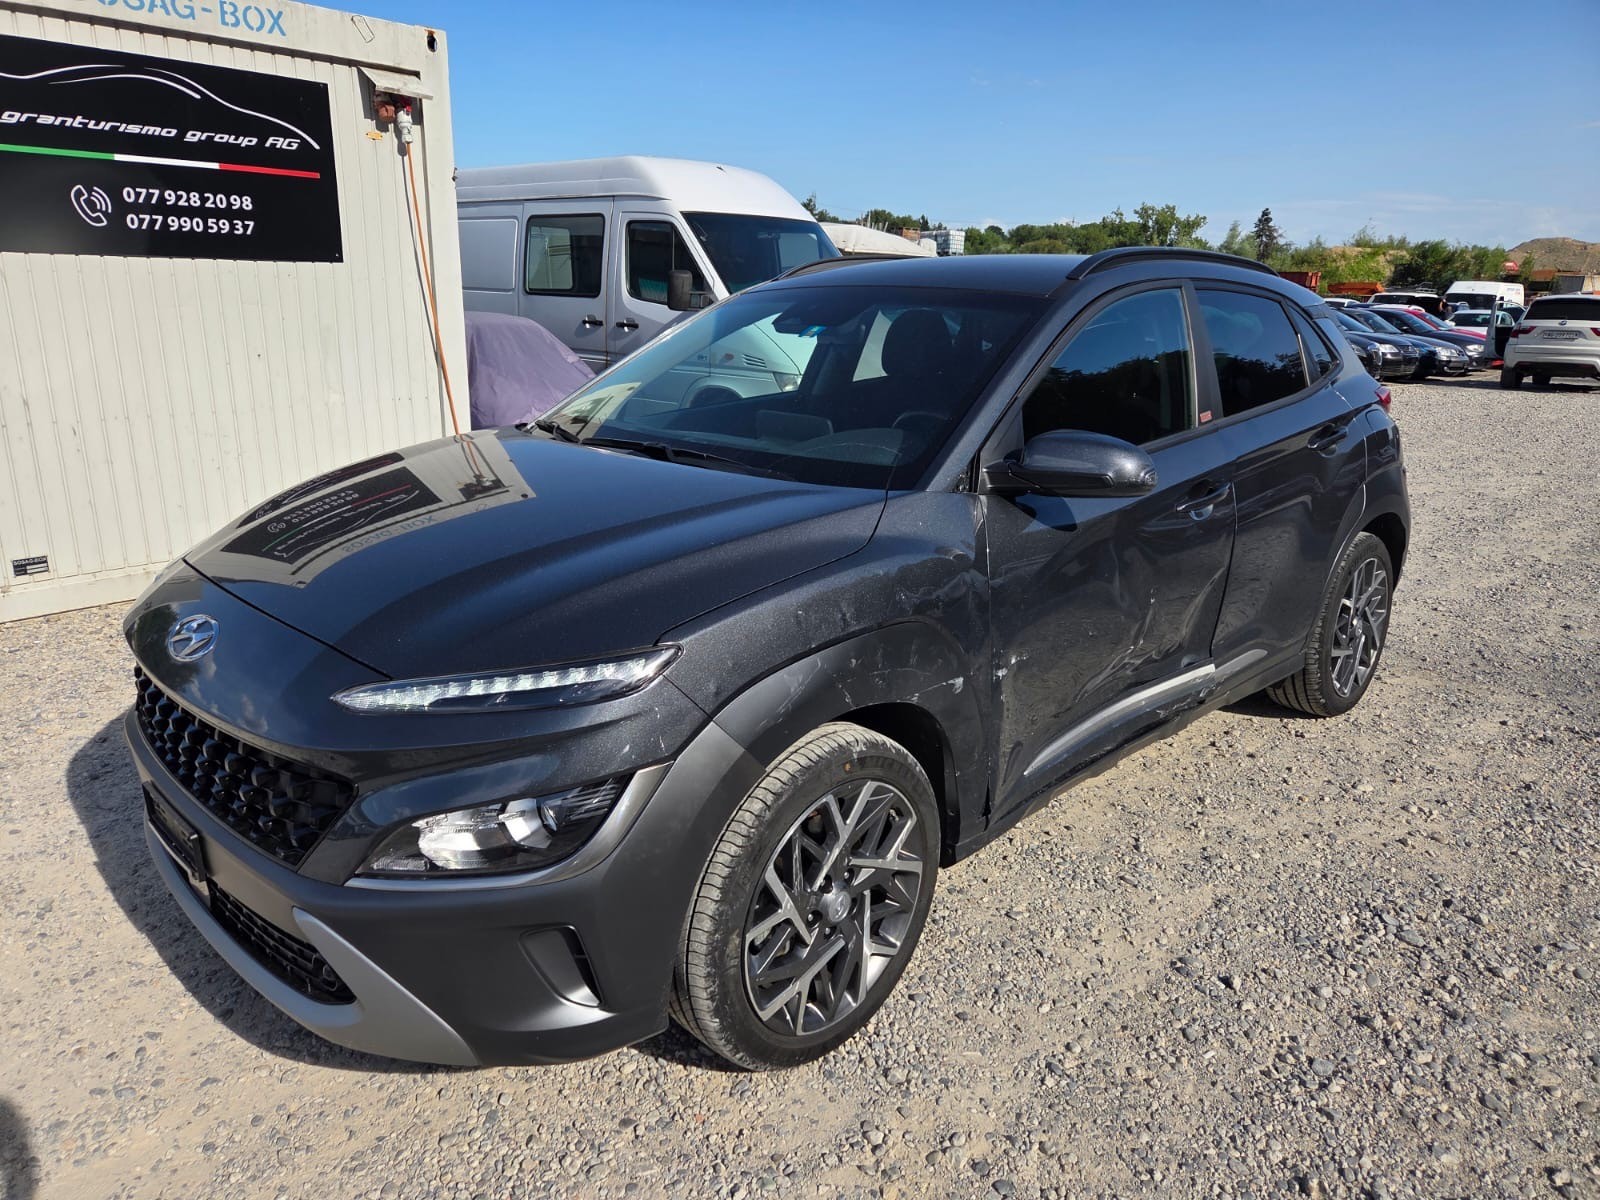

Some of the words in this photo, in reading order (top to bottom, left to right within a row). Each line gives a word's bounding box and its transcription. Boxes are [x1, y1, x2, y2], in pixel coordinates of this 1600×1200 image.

[0, 110, 178, 137] granturismo
[183, 130, 258, 147] group
[264, 136, 301, 150] AG
[122, 187, 160, 204] 077
[164, 190, 201, 207] 928
[203, 193, 227, 209] 20
[229, 195, 253, 211] 98
[126, 213, 163, 230] 077
[167, 216, 204, 232] 990
[207, 218, 230, 234] 59
[233, 220, 255, 235] 37
